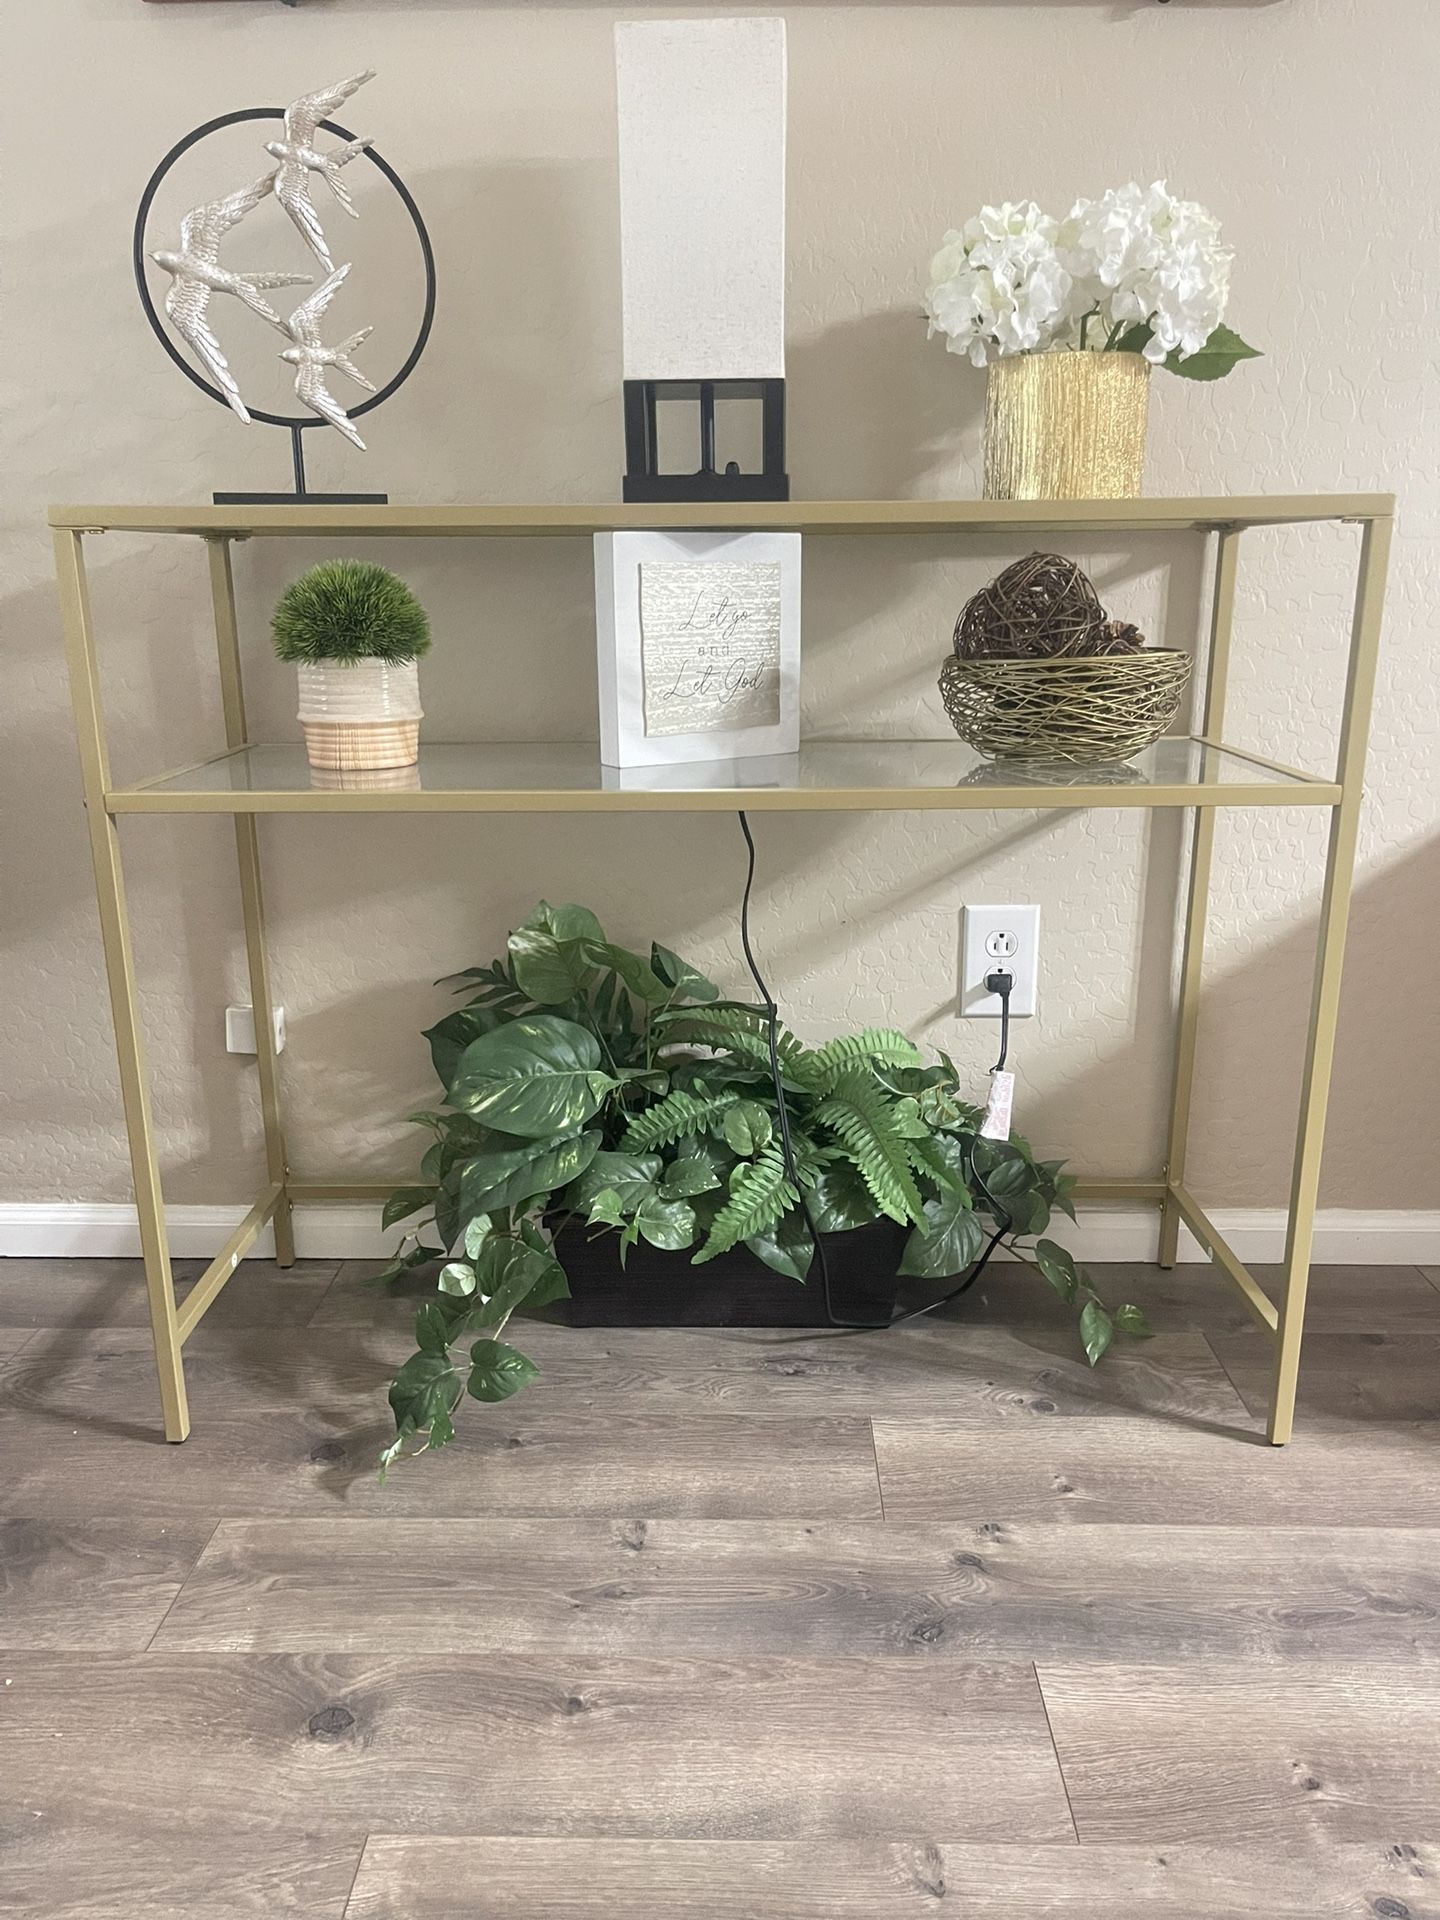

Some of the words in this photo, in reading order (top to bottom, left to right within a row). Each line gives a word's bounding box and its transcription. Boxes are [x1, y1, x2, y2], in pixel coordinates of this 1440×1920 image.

[679, 590, 737, 631] Let
[722, 610, 752, 640] go
[663, 659, 721, 700] Let
[717, 657, 765, 704] God
